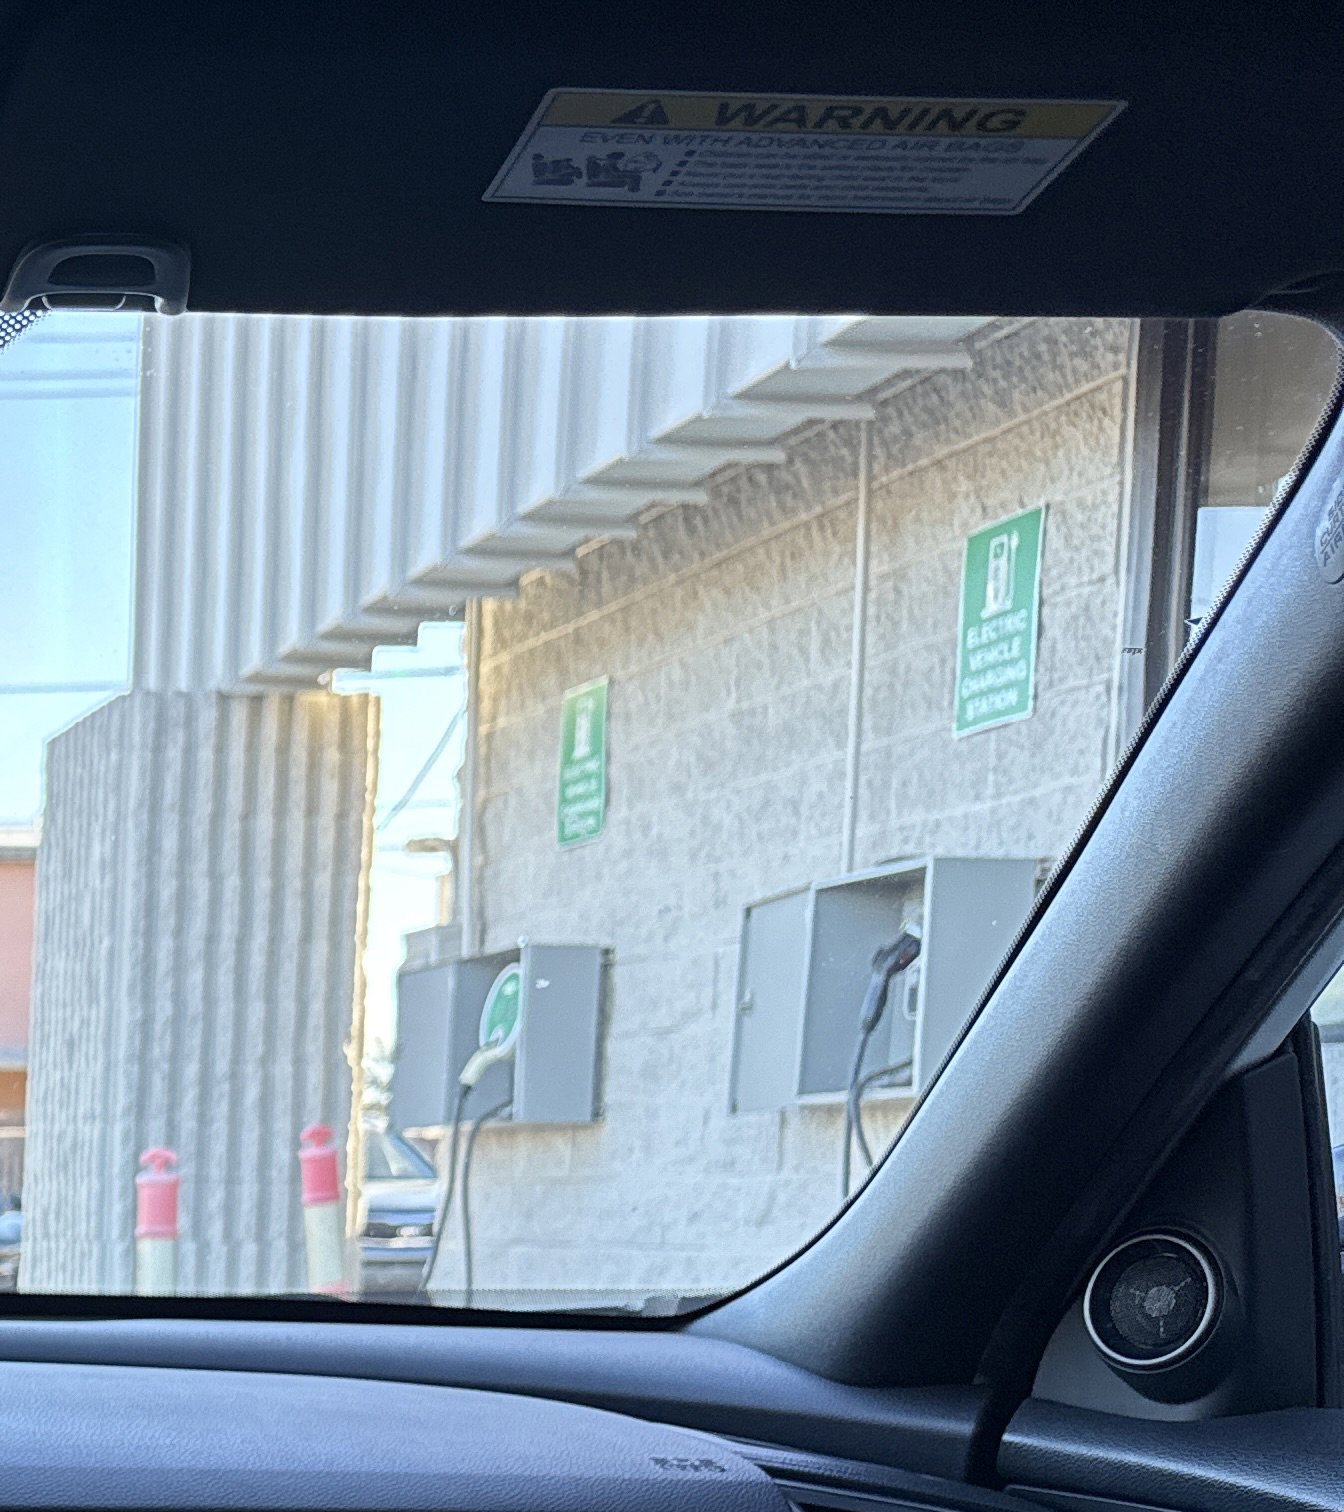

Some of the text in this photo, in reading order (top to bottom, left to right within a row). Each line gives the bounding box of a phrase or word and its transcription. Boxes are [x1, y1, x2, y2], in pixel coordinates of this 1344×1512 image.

[714, 102, 1026, 131] WARNING
[579, 130, 656, 145] EVEN
[662, 132, 724, 147] WITH
[733, 134, 887, 150] ADVANCED
